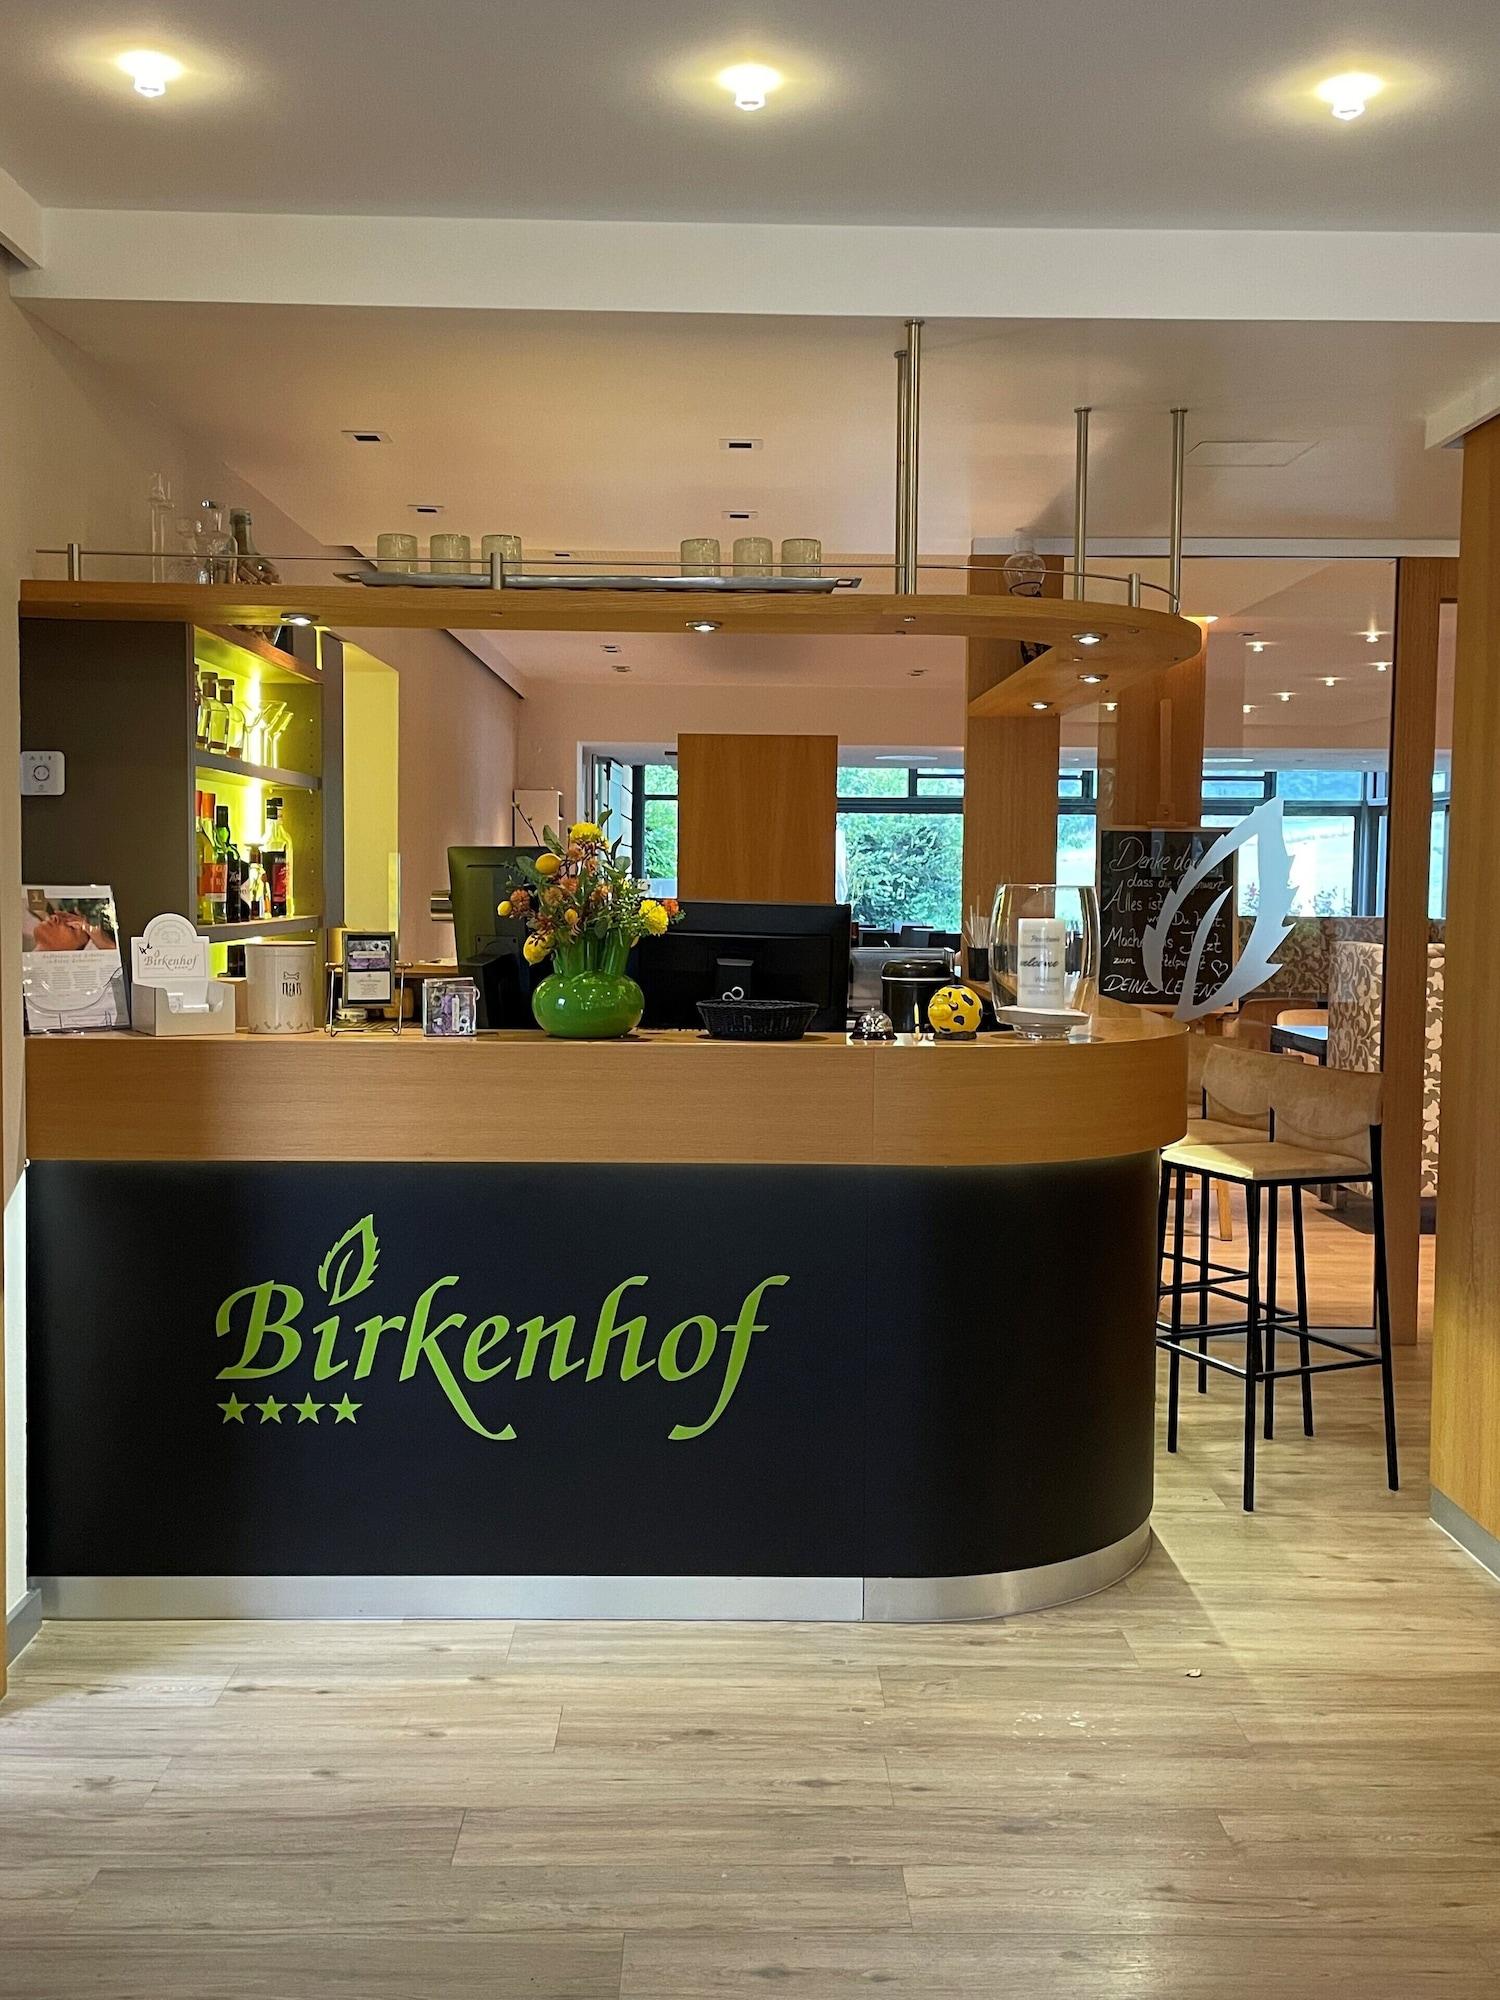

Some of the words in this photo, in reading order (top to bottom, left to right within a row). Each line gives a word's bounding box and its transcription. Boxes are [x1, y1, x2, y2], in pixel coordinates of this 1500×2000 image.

[1109, 836, 1168, 872] Denke
[1127, 872, 1154, 888] dass
[1103, 879, 1143, 913] Alles
[1172, 911, 1191, 926] Du
[1104, 926, 1144, 948] Mach
[144, 953, 199, 971] Birkenhof
[1113, 956, 1136, 965] zum
[215, 1274, 790, 1441] Birkenhof
